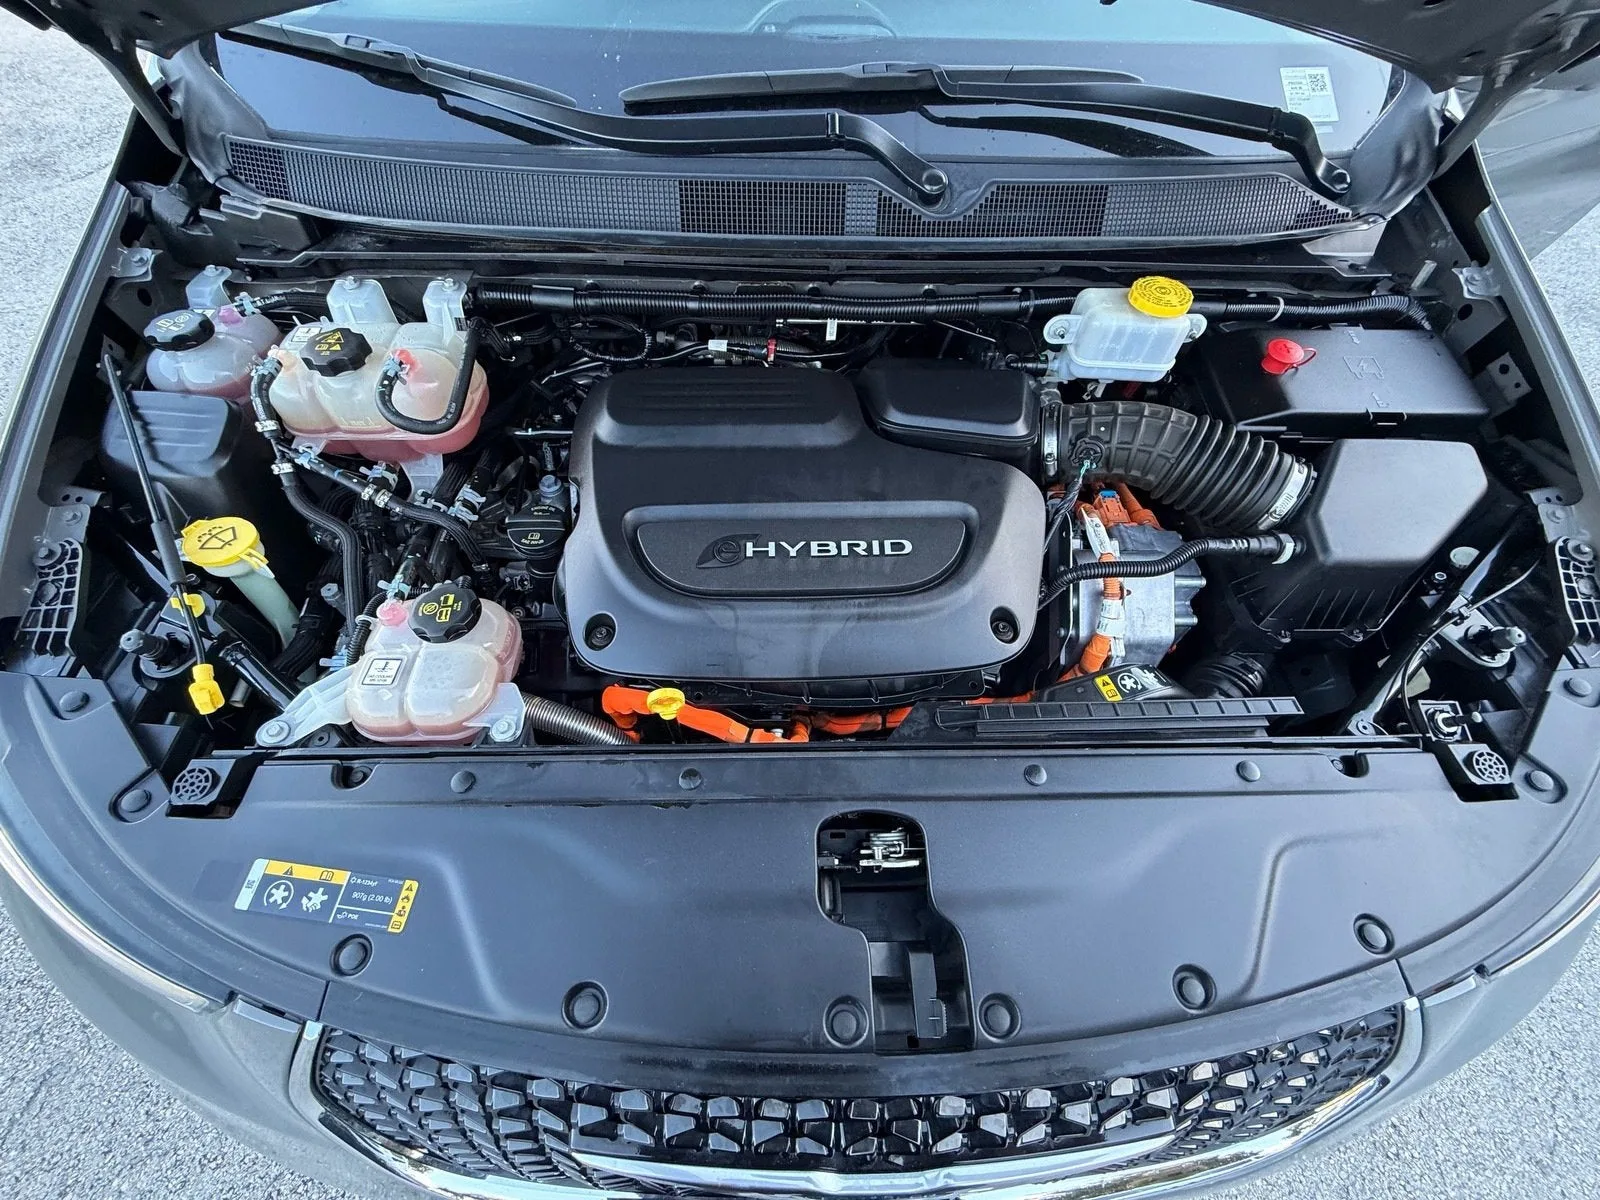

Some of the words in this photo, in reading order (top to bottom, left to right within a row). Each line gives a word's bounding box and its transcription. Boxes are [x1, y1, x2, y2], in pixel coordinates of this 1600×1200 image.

[745, 539, 913, 557] HYBRID
[356, 878, 378, 887] R-1234yf
[352, 891, 367, 901] 907g
[367, 893, 384, 903] (2.00
[383, 896, 393, 904] lb)
